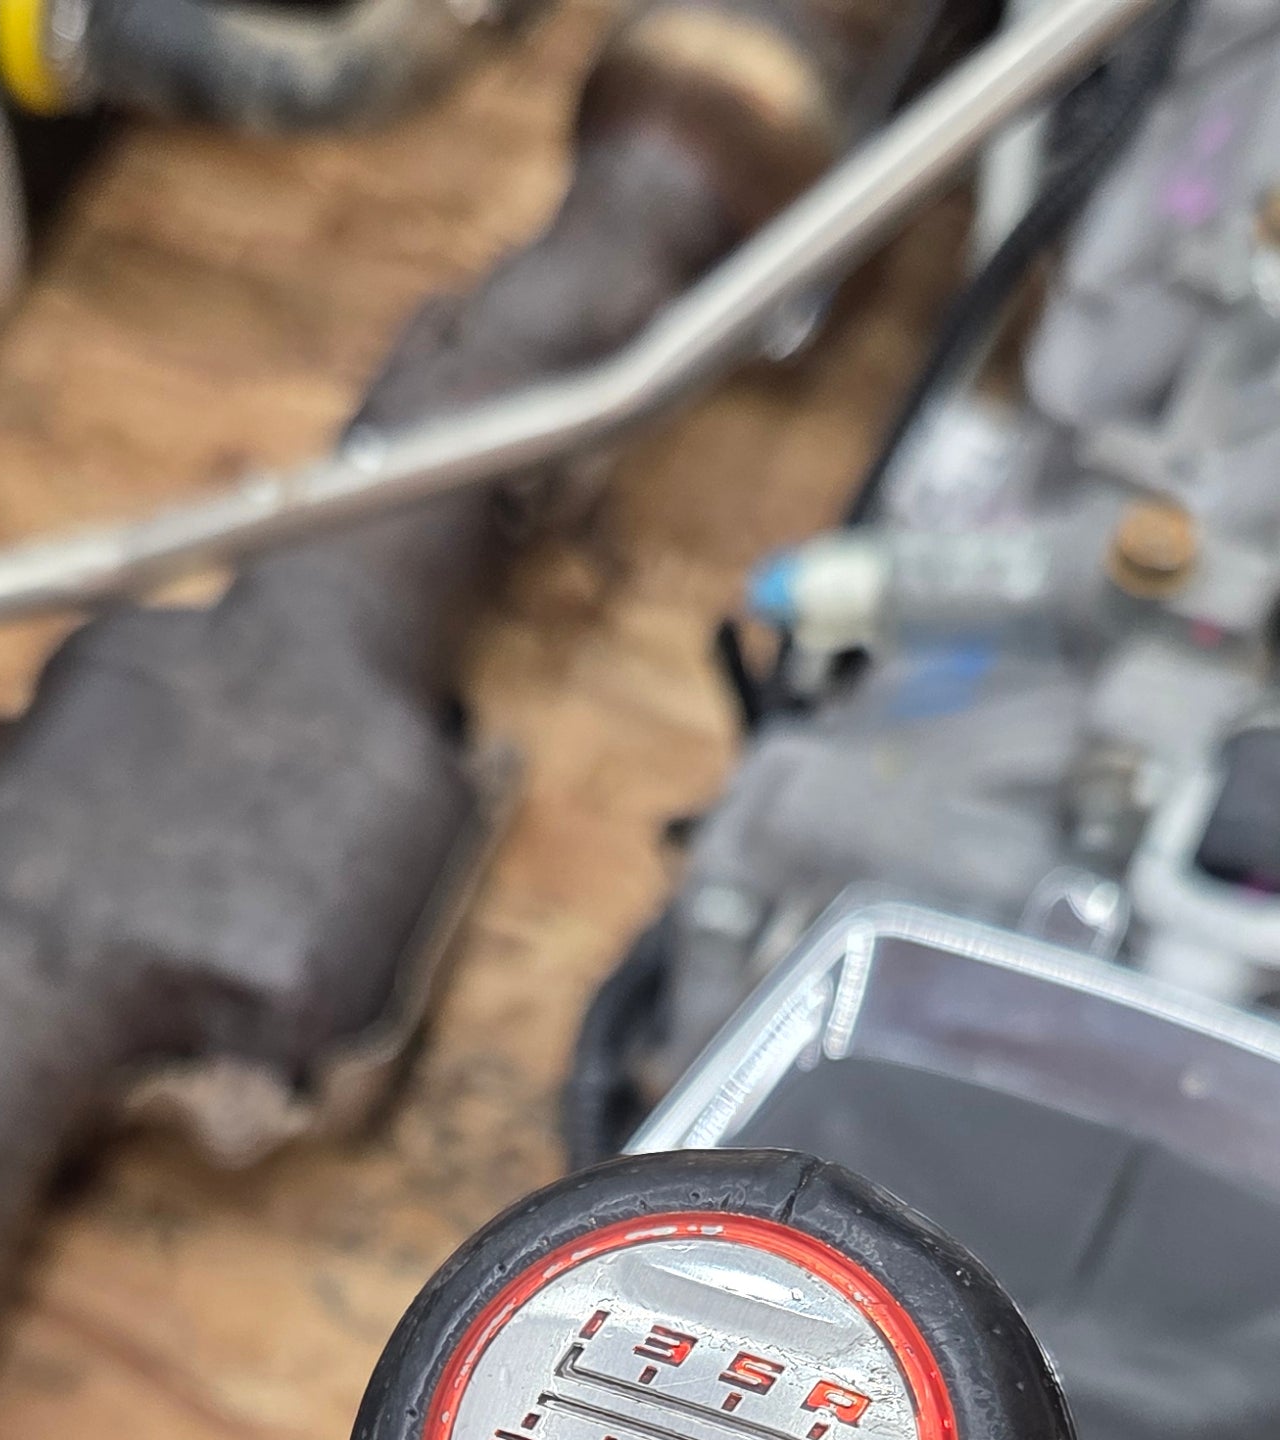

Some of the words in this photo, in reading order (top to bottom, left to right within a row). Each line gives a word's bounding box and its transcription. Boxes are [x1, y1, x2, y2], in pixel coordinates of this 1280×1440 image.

[578, 1309, 610, 1340] 1
[633, 1324, 699, 1367] 3
[718, 1350, 786, 1396] 5
[799, 1378, 872, 1428] R
